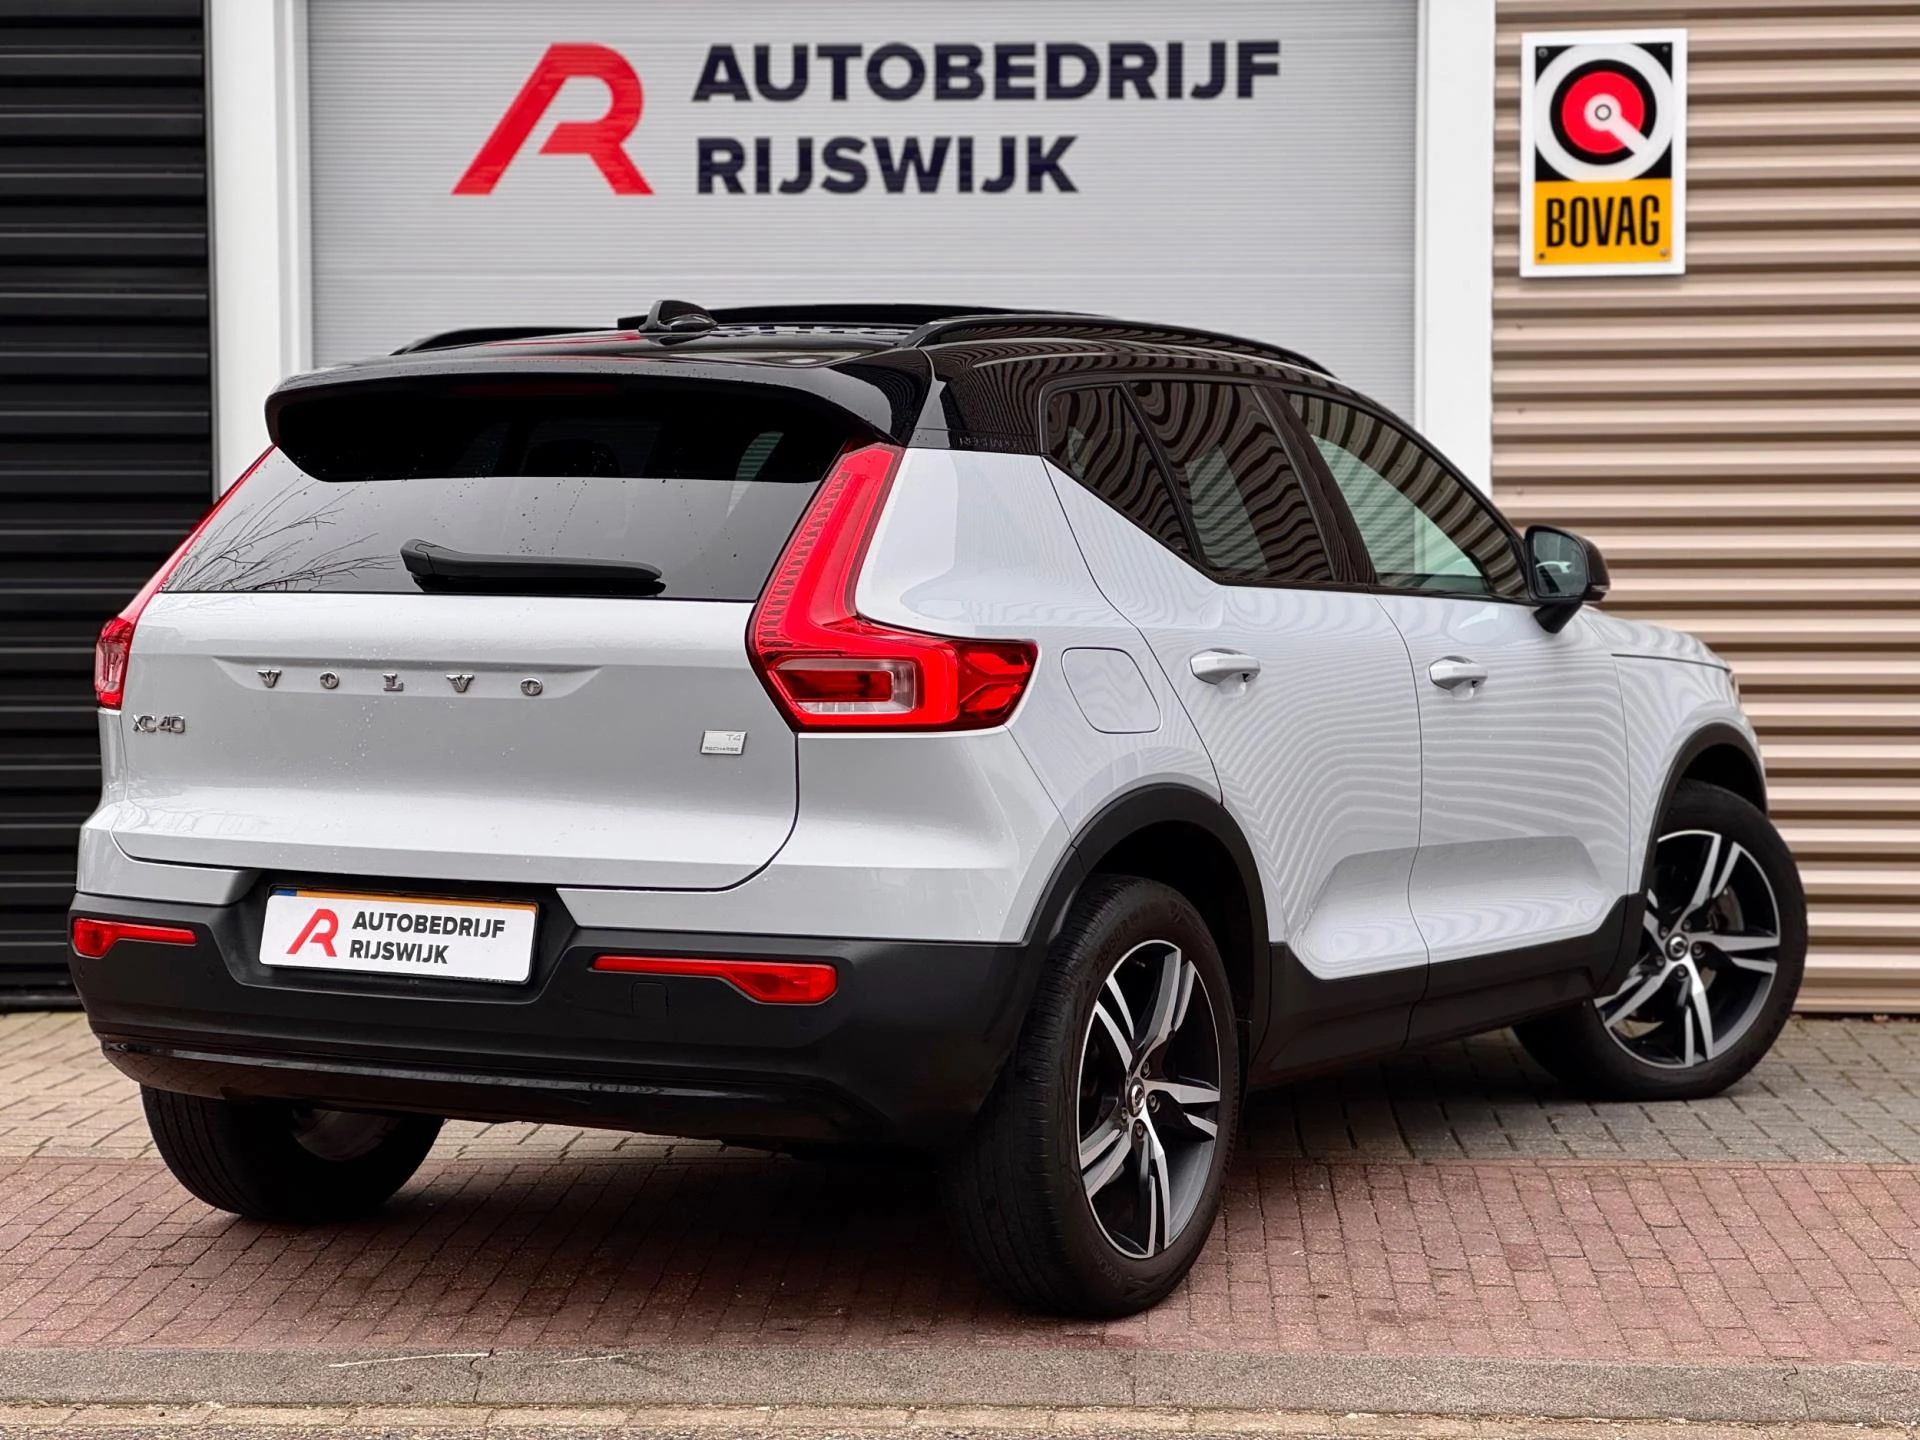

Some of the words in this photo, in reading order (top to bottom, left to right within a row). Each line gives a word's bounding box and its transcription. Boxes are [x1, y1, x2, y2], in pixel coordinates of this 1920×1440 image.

[692, 41, 1281, 102] AUTOBEDRIJF
[697, 135, 1078, 194] RIJSWIJK
[1547, 195, 1659, 247] BOVAG
[256, 669, 543, 697] VOLVO
[352, 911, 506, 938] AUTOBEDRIJF
[349, 940, 449, 964] RIJSWIJK
